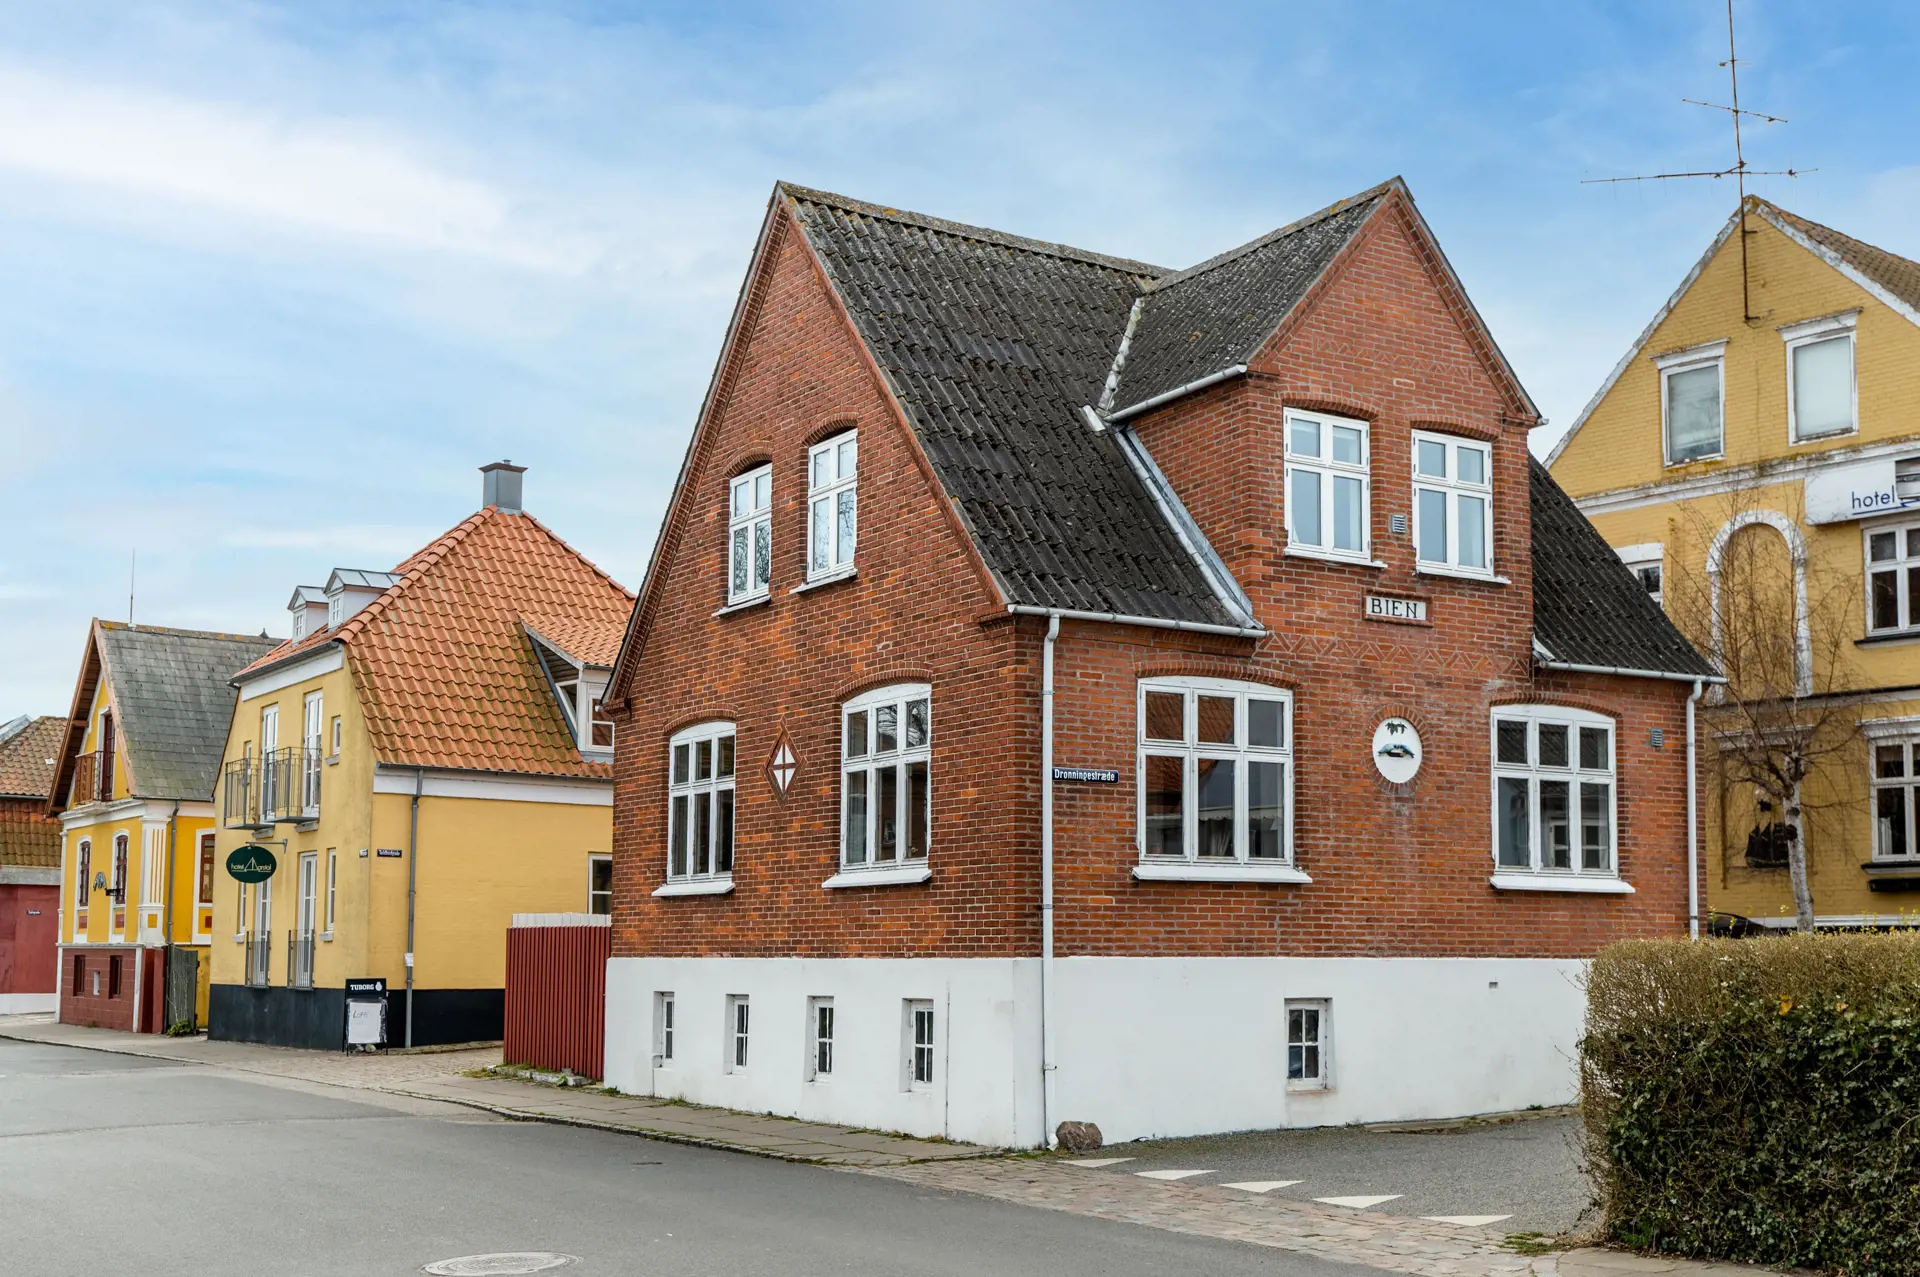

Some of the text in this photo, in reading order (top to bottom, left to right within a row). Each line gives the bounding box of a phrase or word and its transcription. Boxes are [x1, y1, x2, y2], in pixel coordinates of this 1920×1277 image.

[1851, 485, 1895, 509] hotel
[1371, 597, 1418, 618] BIEN
[1054, 768, 1115, 781] Dronningestræde
